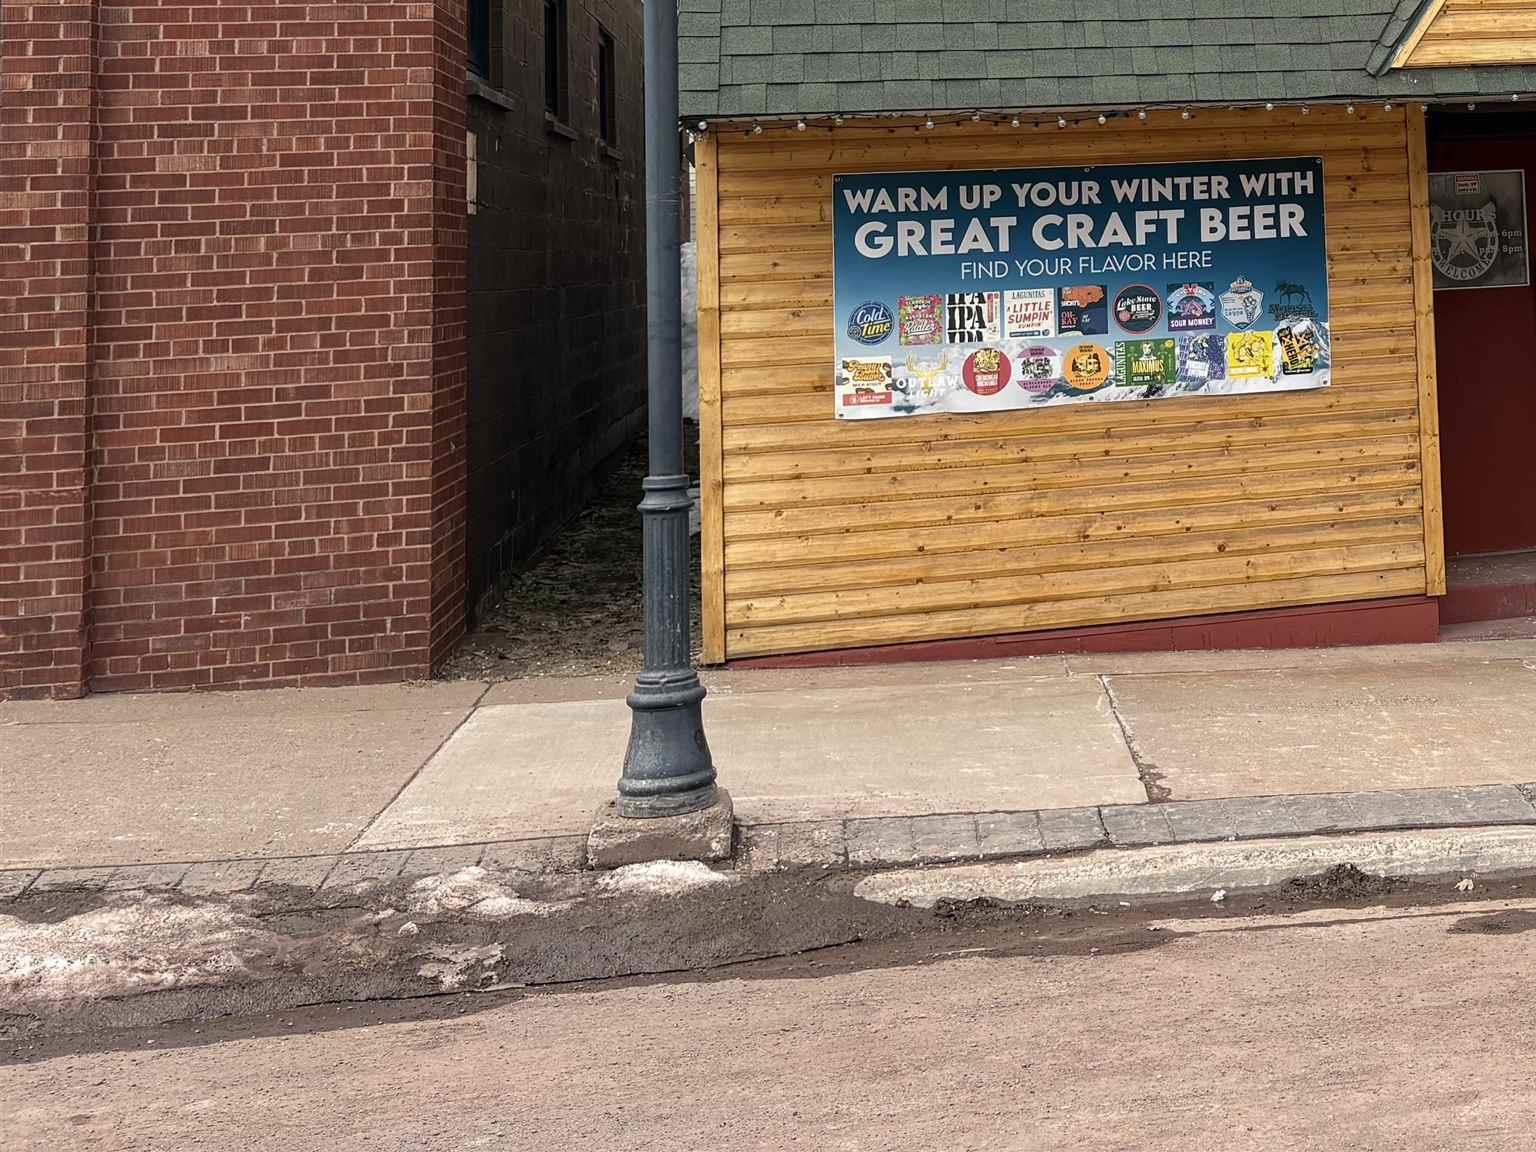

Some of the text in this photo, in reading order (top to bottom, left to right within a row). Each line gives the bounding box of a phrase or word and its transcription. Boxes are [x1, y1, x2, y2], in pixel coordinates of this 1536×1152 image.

[842, 170, 1315, 214] WARM UP YOUR WINTER WITH
[854, 203, 1309, 259] GREAT CRAFT BEER
[961, 250, 1212, 280] FIND YOUR FLAVOR HERE
[856, 306, 884, 324] Cold
[1013, 301, 1051, 313] LITTLE
[947, 305, 987, 330] IPA
[1170, 318, 1187, 328] SOUR
[862, 320, 890, 337] Time
[1132, 360, 1164, 373] MAXIMUS
